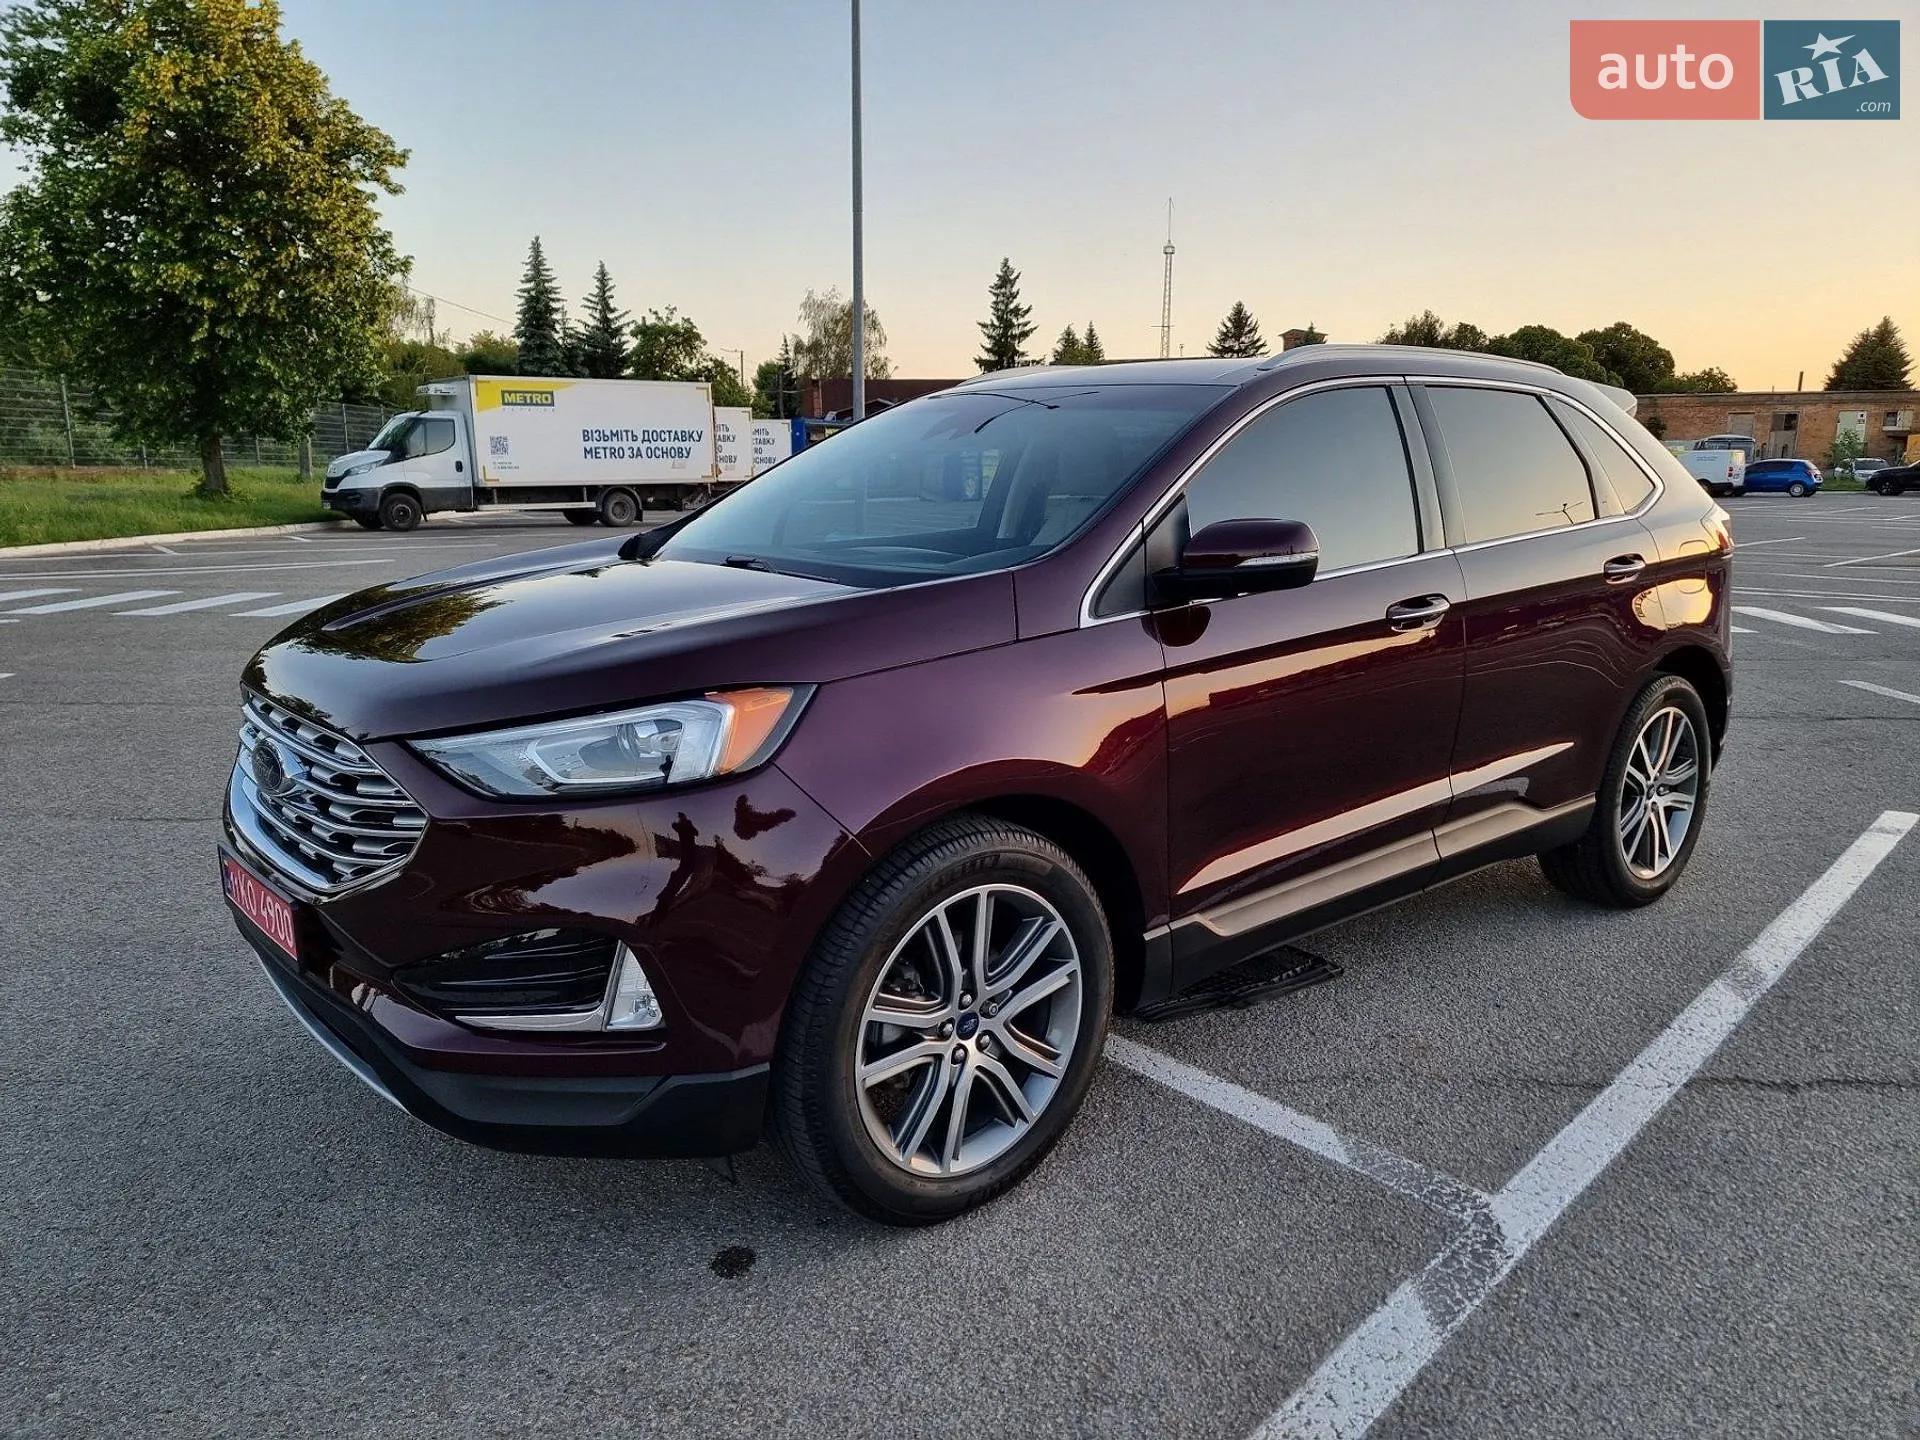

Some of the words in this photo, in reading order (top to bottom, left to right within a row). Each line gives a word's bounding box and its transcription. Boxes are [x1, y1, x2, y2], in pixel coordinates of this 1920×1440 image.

[504, 392, 552, 404] METRO
[582, 429, 639, 442] ВІЗЬМІТЬ
[641, 430, 703, 444] ДОСТАВКУ
[583, 446, 625, 460] METRO
[628, 447, 643, 459] ЗА
[645, 446, 692, 459] ОСНОВУ
